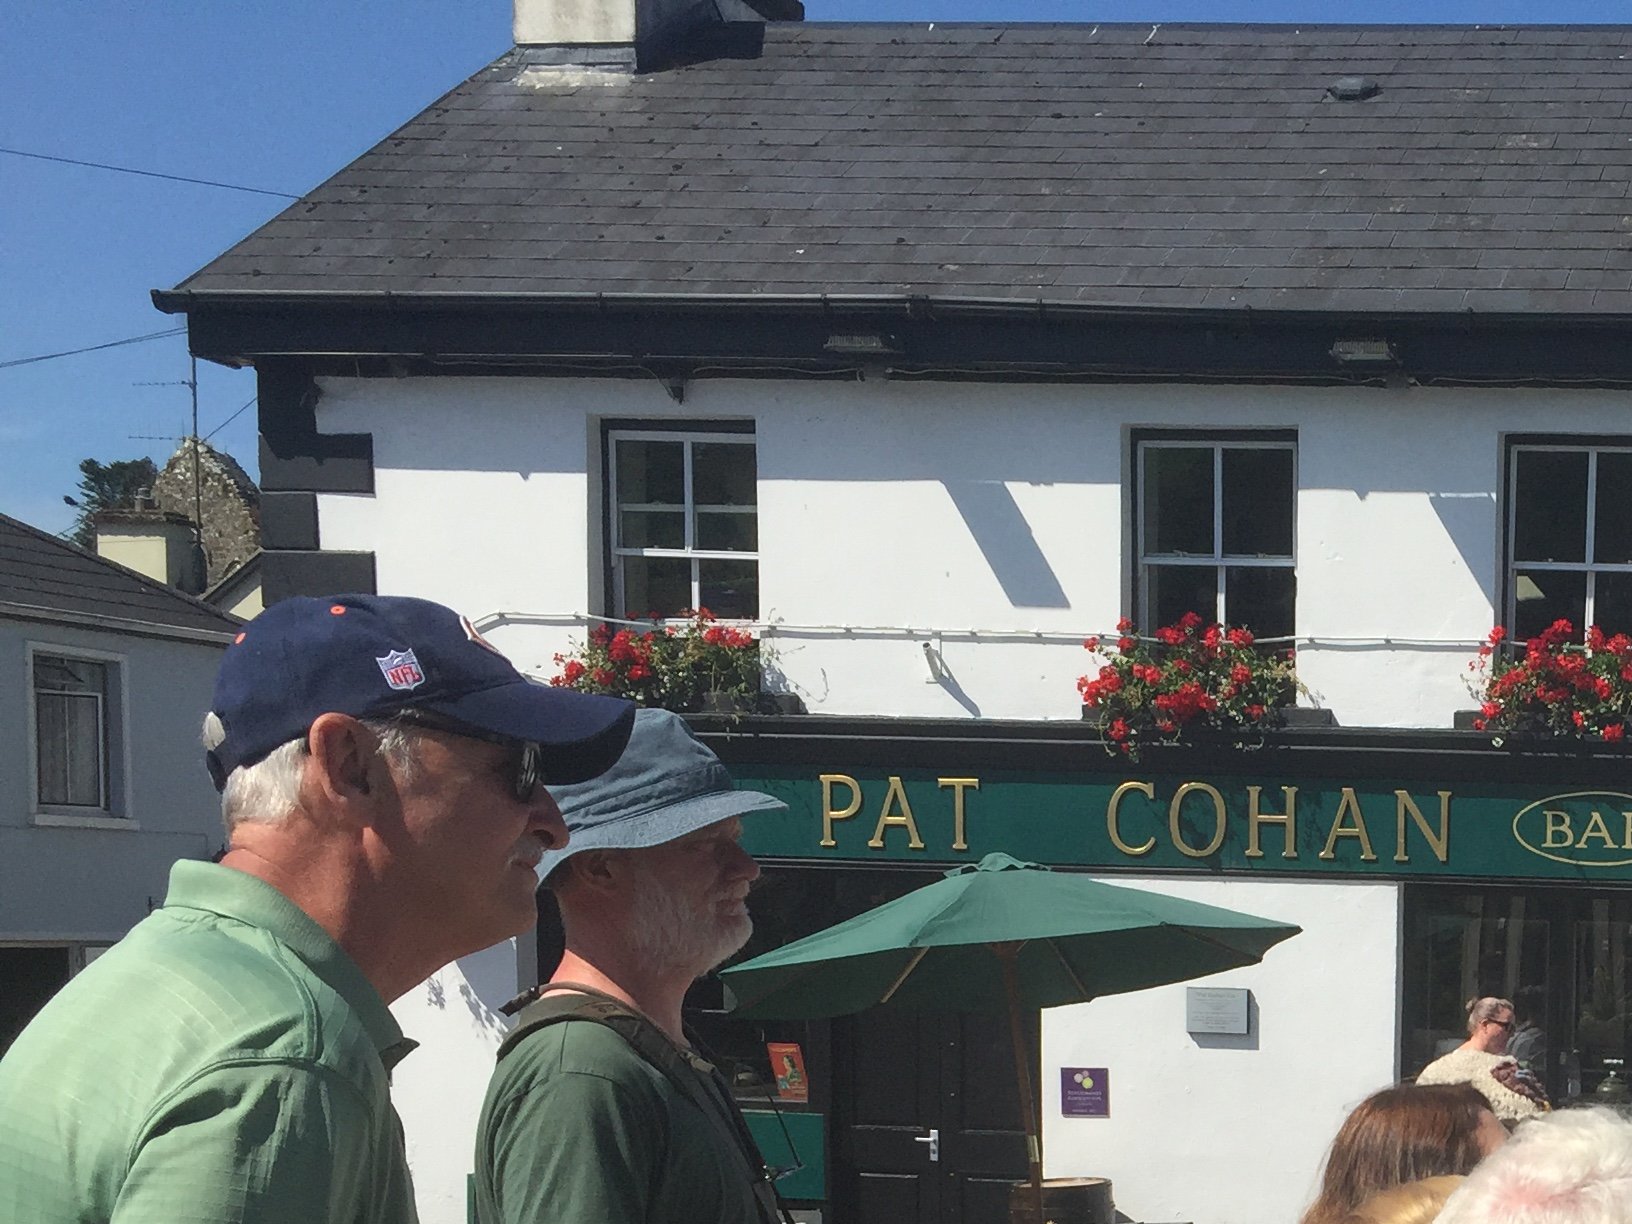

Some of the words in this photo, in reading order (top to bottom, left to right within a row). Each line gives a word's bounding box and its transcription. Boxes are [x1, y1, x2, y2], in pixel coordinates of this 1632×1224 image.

[388, 665, 421, 685] NFL
[819, 774, 980, 850] PAT
[1107, 781, 1453, 862] COHAN
